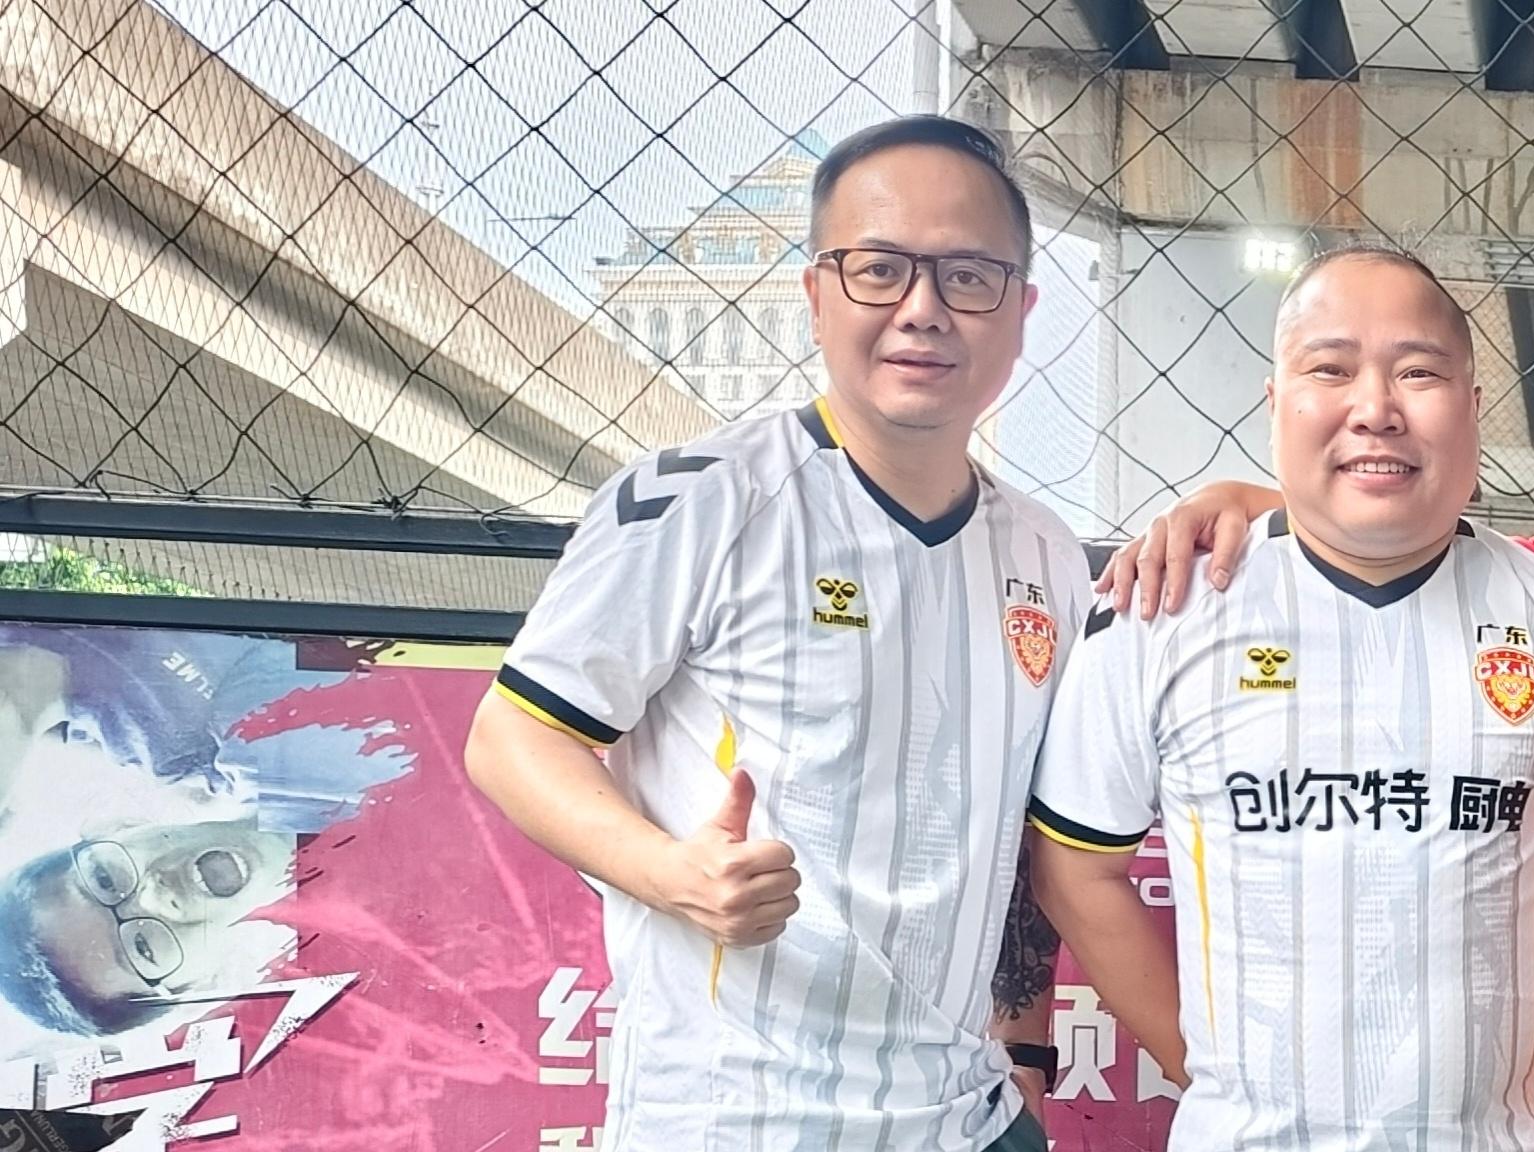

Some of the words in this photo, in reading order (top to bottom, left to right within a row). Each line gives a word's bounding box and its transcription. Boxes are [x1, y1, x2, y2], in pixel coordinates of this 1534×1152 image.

[1006, 577, 1045, 605] 广东
[812, 607, 869, 629] hummel
[1476, 623, 1529, 645] 广东
[1239, 676, 1297, 691] hummel
[1224, 767, 1431, 834] 创尔特
[1448, 774, 1532, 834] 厨电
